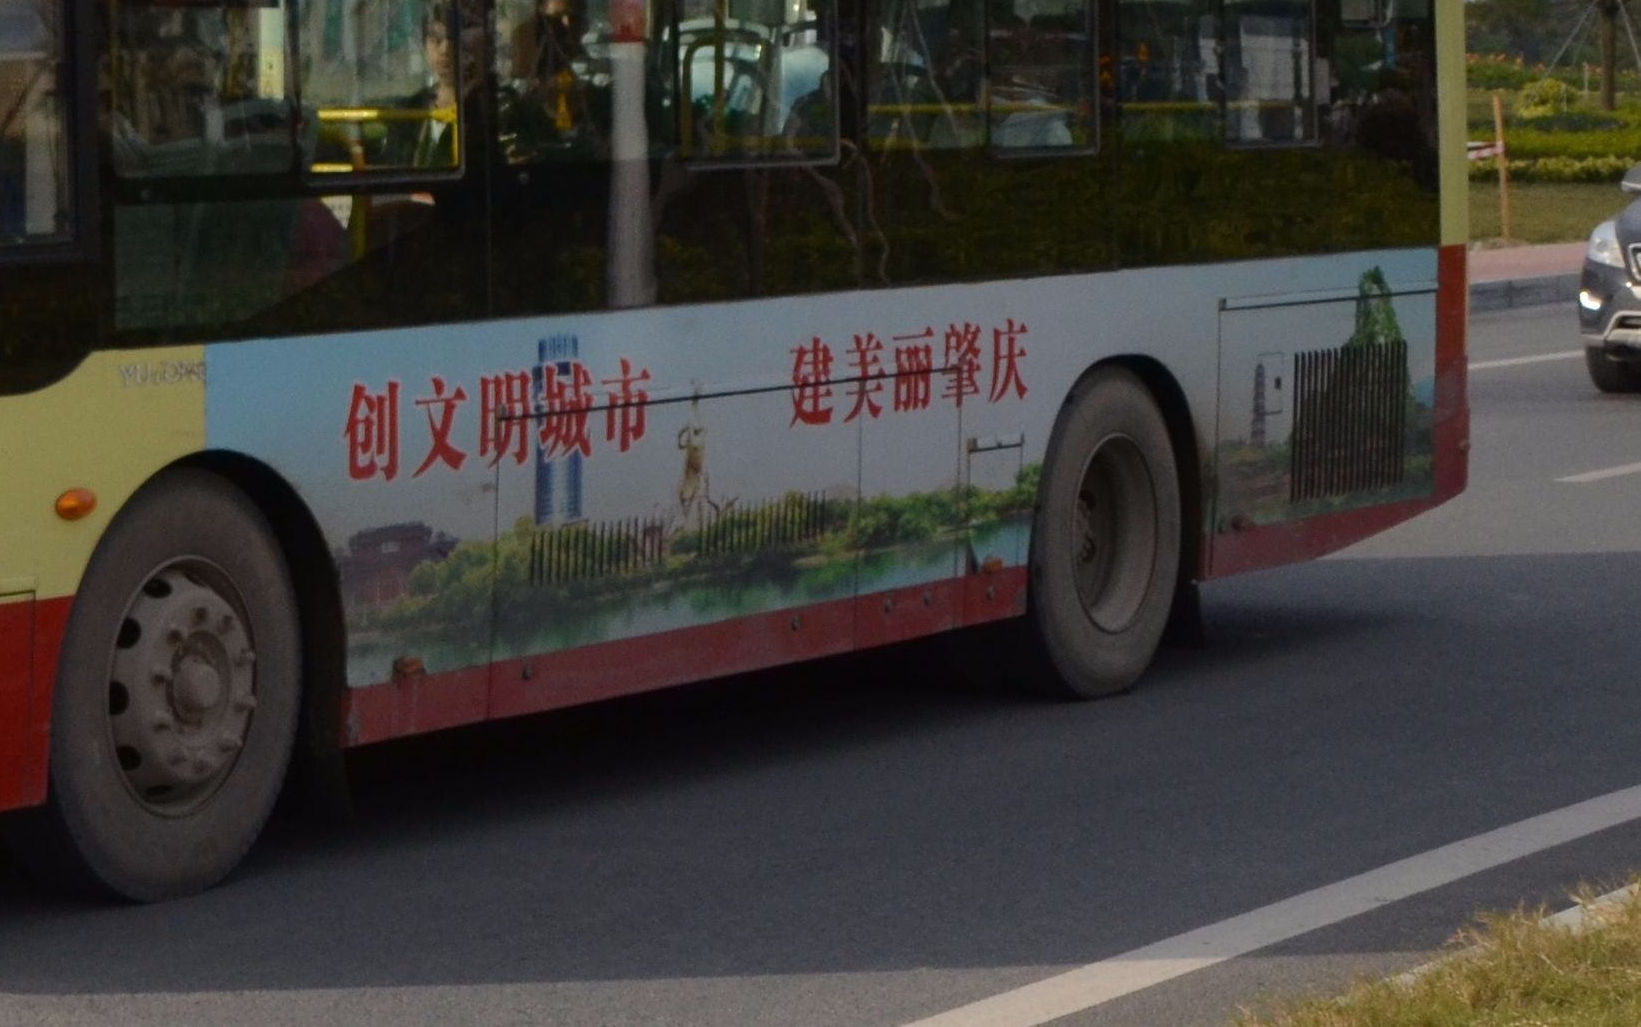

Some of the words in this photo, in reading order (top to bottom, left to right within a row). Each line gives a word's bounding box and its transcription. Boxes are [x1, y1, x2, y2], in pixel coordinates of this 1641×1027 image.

[343, 356, 652, 482] 创文明城市
[788, 317, 1028, 428] 建美丽肇庆
